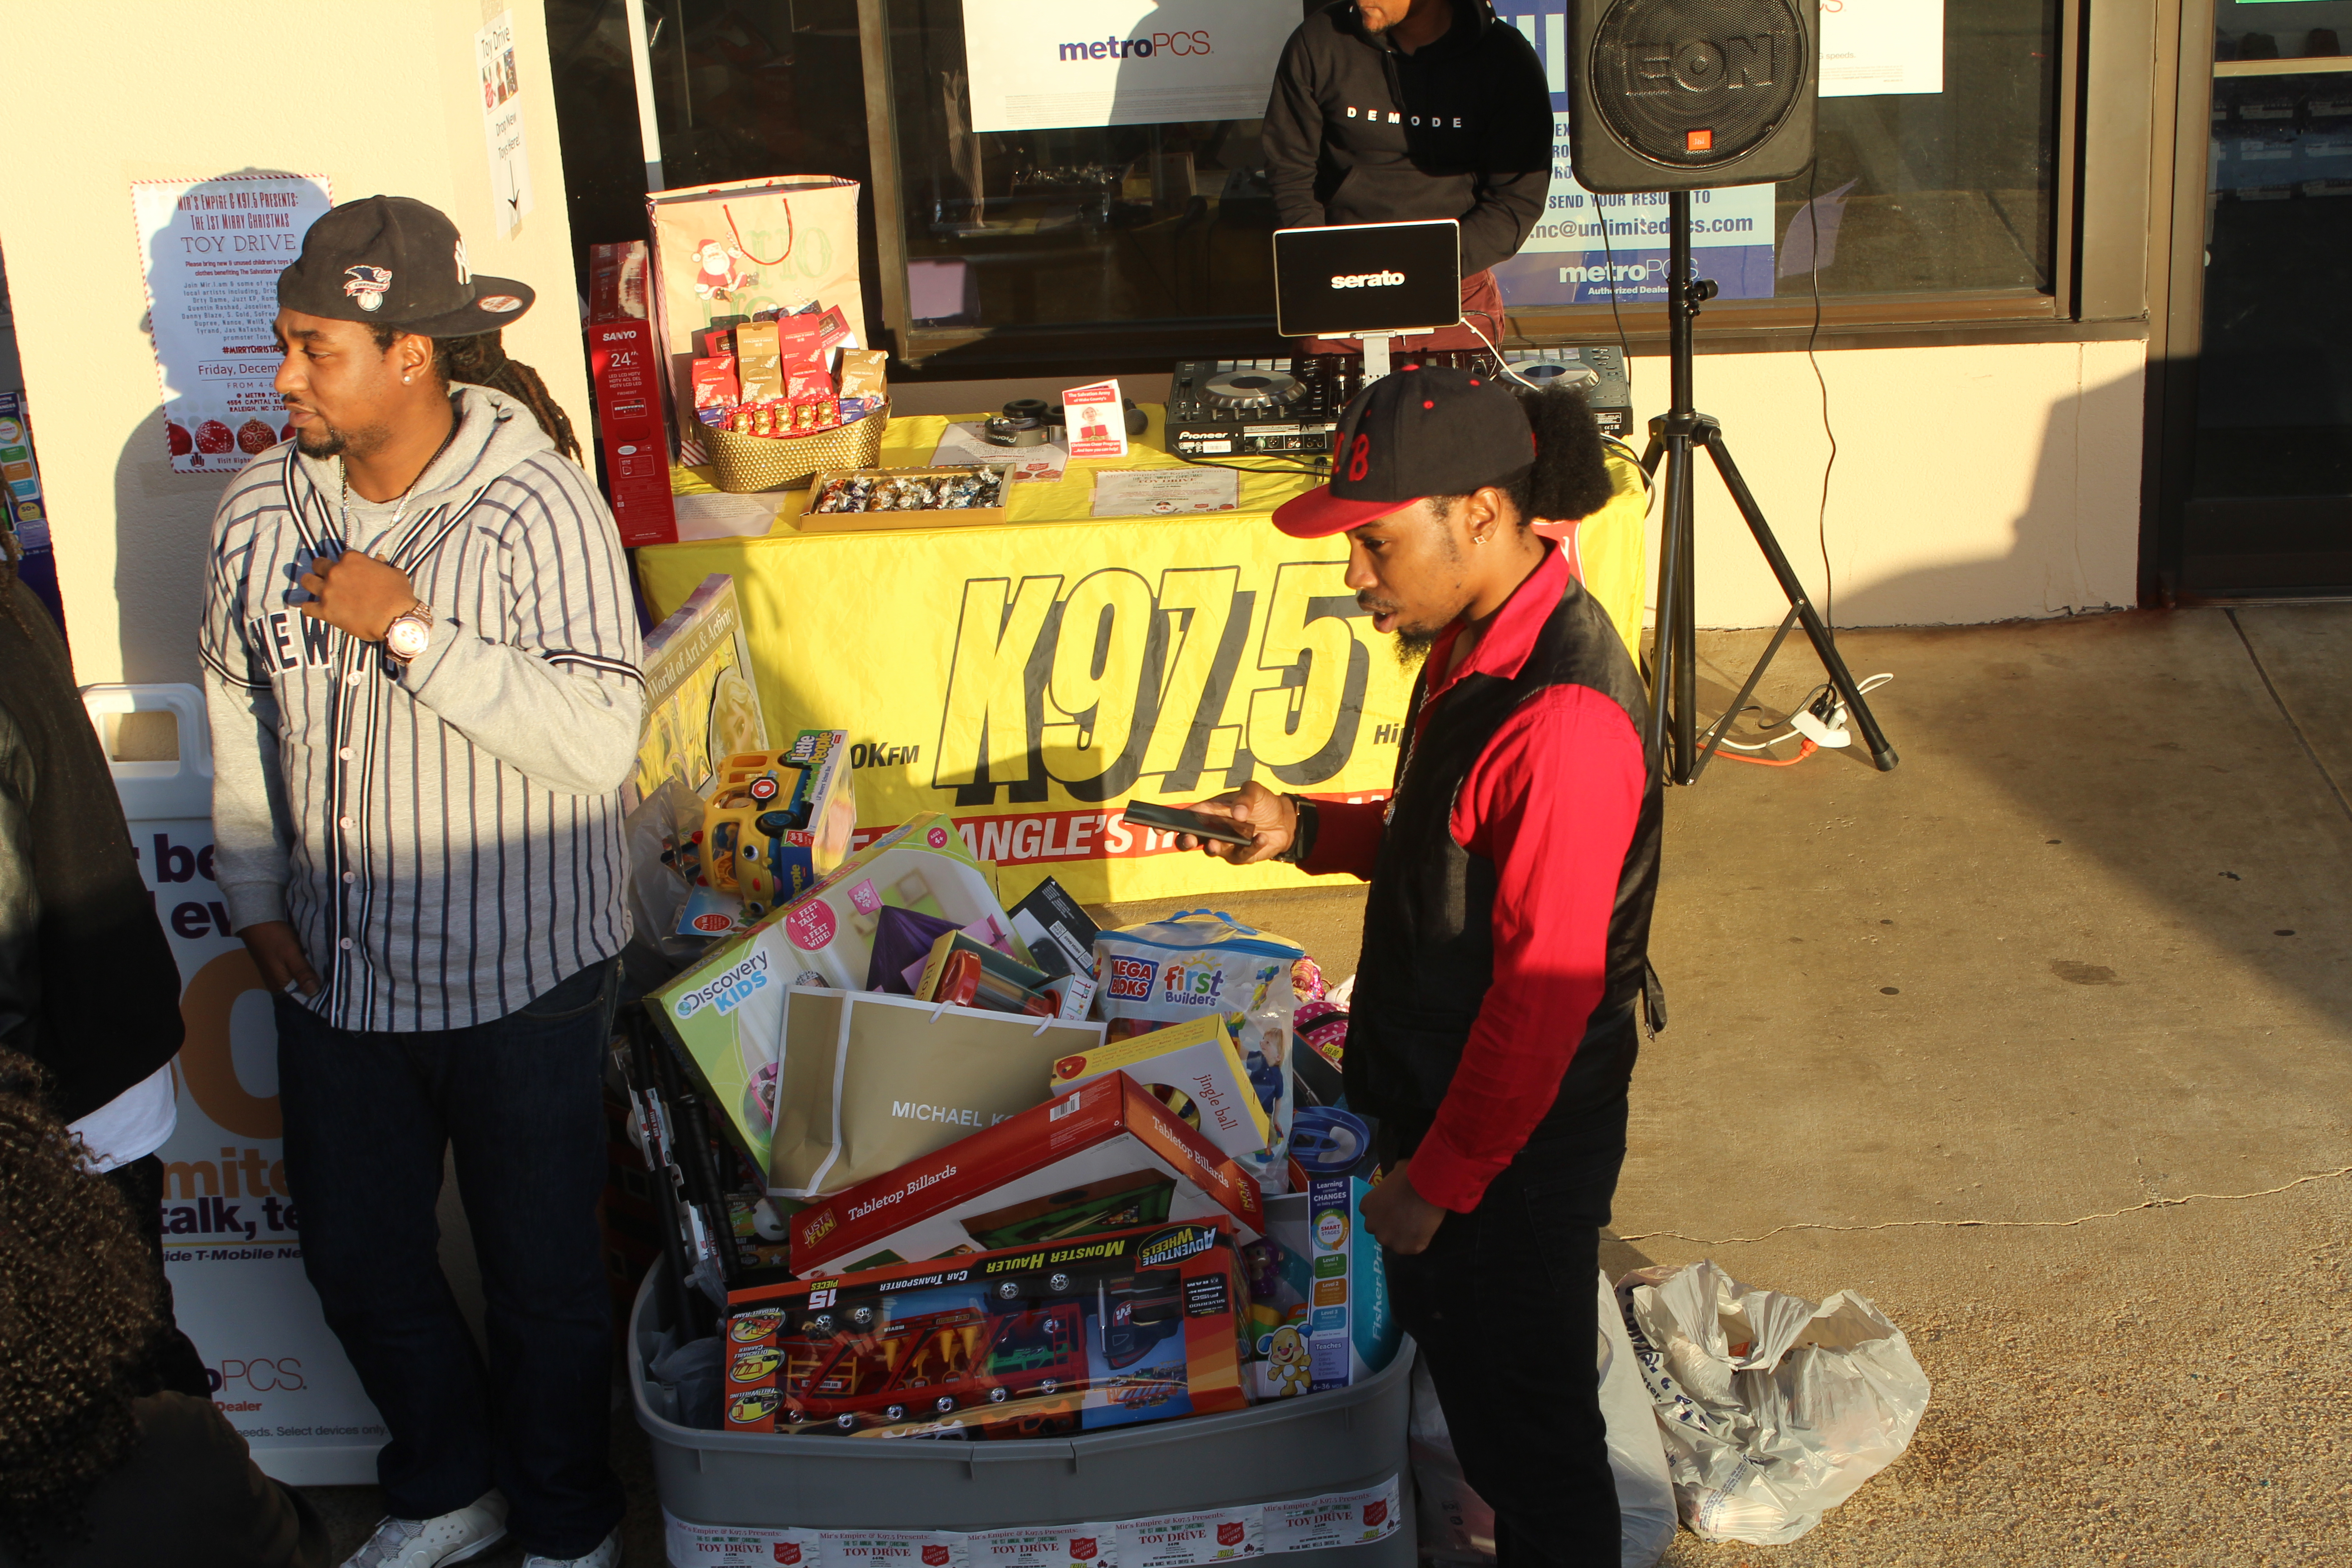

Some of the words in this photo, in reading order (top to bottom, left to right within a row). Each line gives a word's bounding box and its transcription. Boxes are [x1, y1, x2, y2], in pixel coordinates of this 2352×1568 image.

[481, 39, 493, 60] Toy
[493, 25, 510, 51] Drive
[1548, 195, 1584, 209] SEND
[1591, 193, 1626, 207] YOUR
[1694, 190, 1710, 204] TO
[181, 236, 225, 253] TOY
[235, 234, 296, 251] DRIVE
[745, 227, 833, 289] HO
[1331, 270, 1405, 289] serato
[1588, 287, 1639, 295] Authorized
[1640, 286, 1669, 294] Dealer
[603, 330, 637, 342] SANYO
[199, 364, 236, 376] Friday,
[1179, 431, 1229, 440] Pioneer
[250, 608, 333, 677] NEW
[647, 662, 677, 701] World
[676, 652, 686, 675] of
[685, 640, 700, 668] Art
[699, 632, 708, 652] &
[708, 605, 735, 644] Activity
[931, 561, 1370, 807] K97.5
[791, 735, 815, 761] Little
[808, 731, 834, 764] People
[930, 830, 941, 840] AGES
[799, 902, 818, 918] FEET
[798, 913, 818, 928] TALL
[808, 922, 828, 939] FEET
[807, 931, 832, 948] WIDE!
[1112, 960, 1152, 980] MEGA
[683, 950, 768, 1011] Discovery
[1110, 977, 1150, 997] BLOKS
[1164, 965, 1224, 997] first
[714, 970, 768, 1013] KIDS
[1166, 991, 1216, 1007] Builders
[1323, 1045, 1339, 1057] $59.00
[1193, 1074, 1225, 1107] jingle
[1214, 1106, 1239, 1131] ball
[1152, 1115, 1193, 1158] Tabletop
[1194, 1150, 1230, 1188] Billards
[848, 1189, 904, 1221] Tabletop
[906, 1165, 957, 1196] Billards
[1317, 1181, 1343, 1189] Learning
[1313, 1191, 1347, 1201] CHANGES
[808, 1220, 834, 1244] FUN
[1142, 1227, 1194, 1258] WHEELS
[1142, 1226, 1217, 1267] ADVENTURE
[1050, 1240, 1125, 1263] MONSTER
[986, 1252, 1045, 1274] HAULER
[811, 1279, 839, 1291] PIECES
[879, 1274, 944, 1292] TRANSPORTER
[946, 1271, 968, 1282] CAR
[1187, 1279, 1209, 1288] RAM
[808, 1289, 837, 1310] 15
[1189, 1298, 1225, 1308] SILVERADO
[1316, 1342, 1342, 1350] Teaches
[215, 1401, 262, 1412] Dealer
[277, 1426, 312, 1436] Select
[315, 1425, 359, 1436] devices
[362, 1424, 389, 1437] only.
[1285, 1517, 1312, 1528] TOY
[1314, 1511, 1353, 1524] DRIVE
[1138, 1535, 1166, 1544] TOY
[1167, 1529, 1206, 1542] DRIVE
[696, 1543, 721, 1553] TOY
[724, 1542, 764, 1553] DRIVE
[843, 1548, 869, 1557] TOY
[872, 1547, 911, 1557] DRIVE
[991, 1546, 1017, 1554] TOY
[1019, 1543, 1059, 1553] DRIVE
